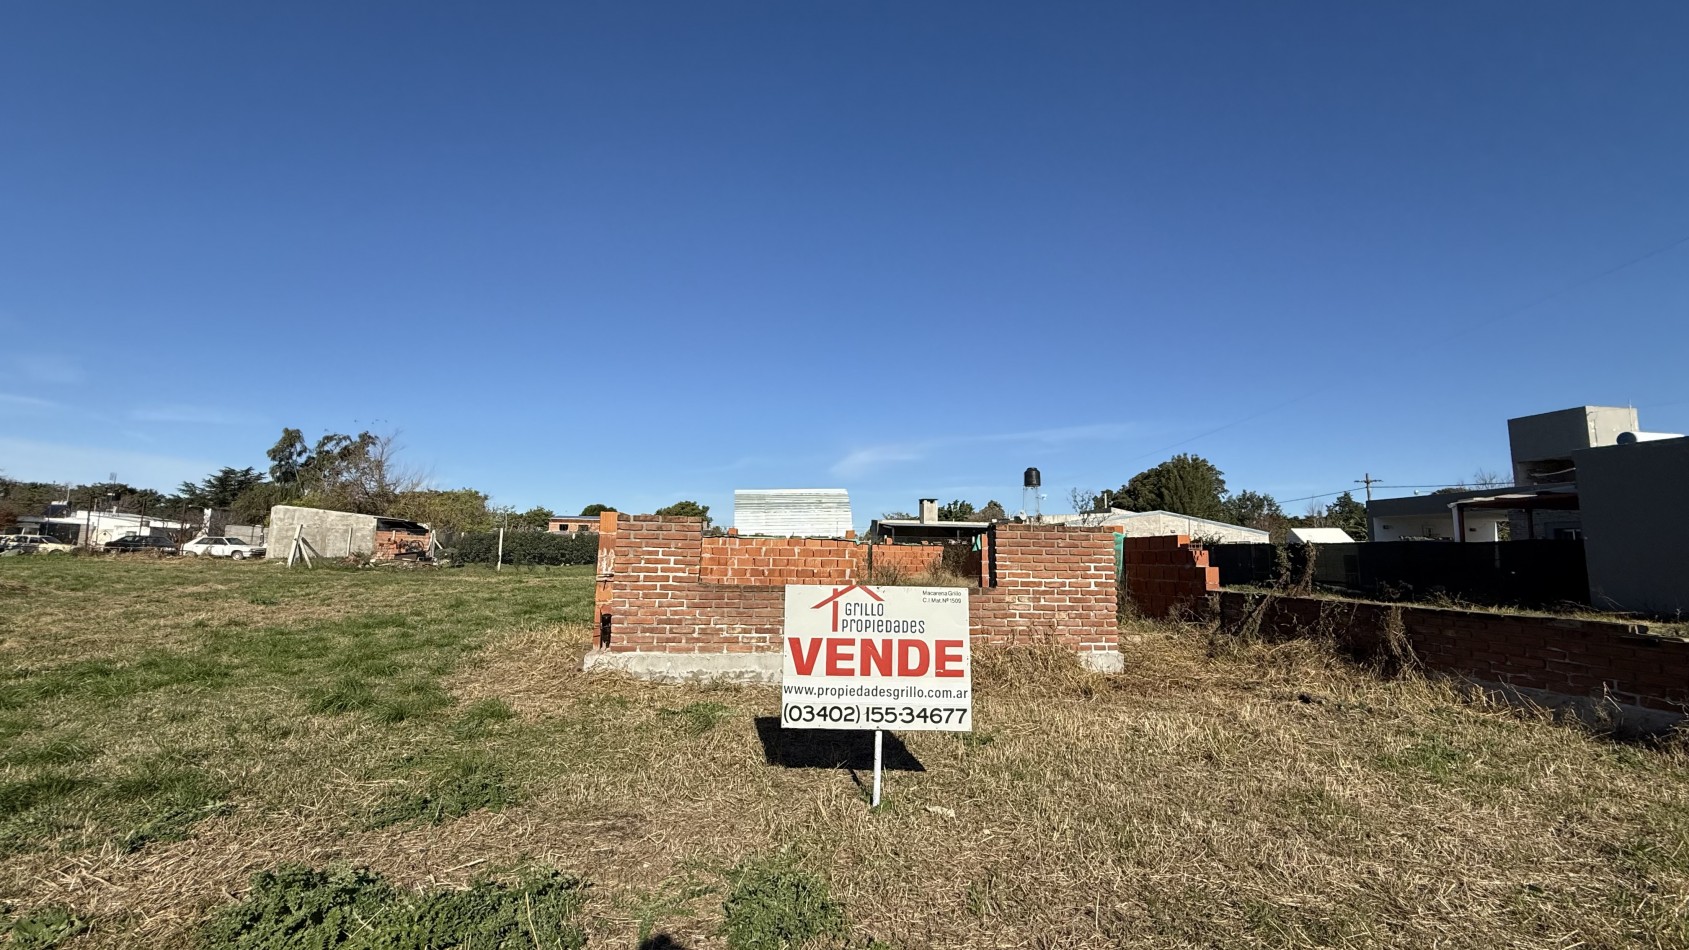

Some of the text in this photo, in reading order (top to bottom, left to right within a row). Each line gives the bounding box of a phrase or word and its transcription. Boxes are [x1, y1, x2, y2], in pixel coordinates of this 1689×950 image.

[787, 637, 964, 678] VENDE
[783, 685, 968, 700] www.propiedadesgrillo.com.ar
[783, 702, 968, 724] (03402) 155-34677
